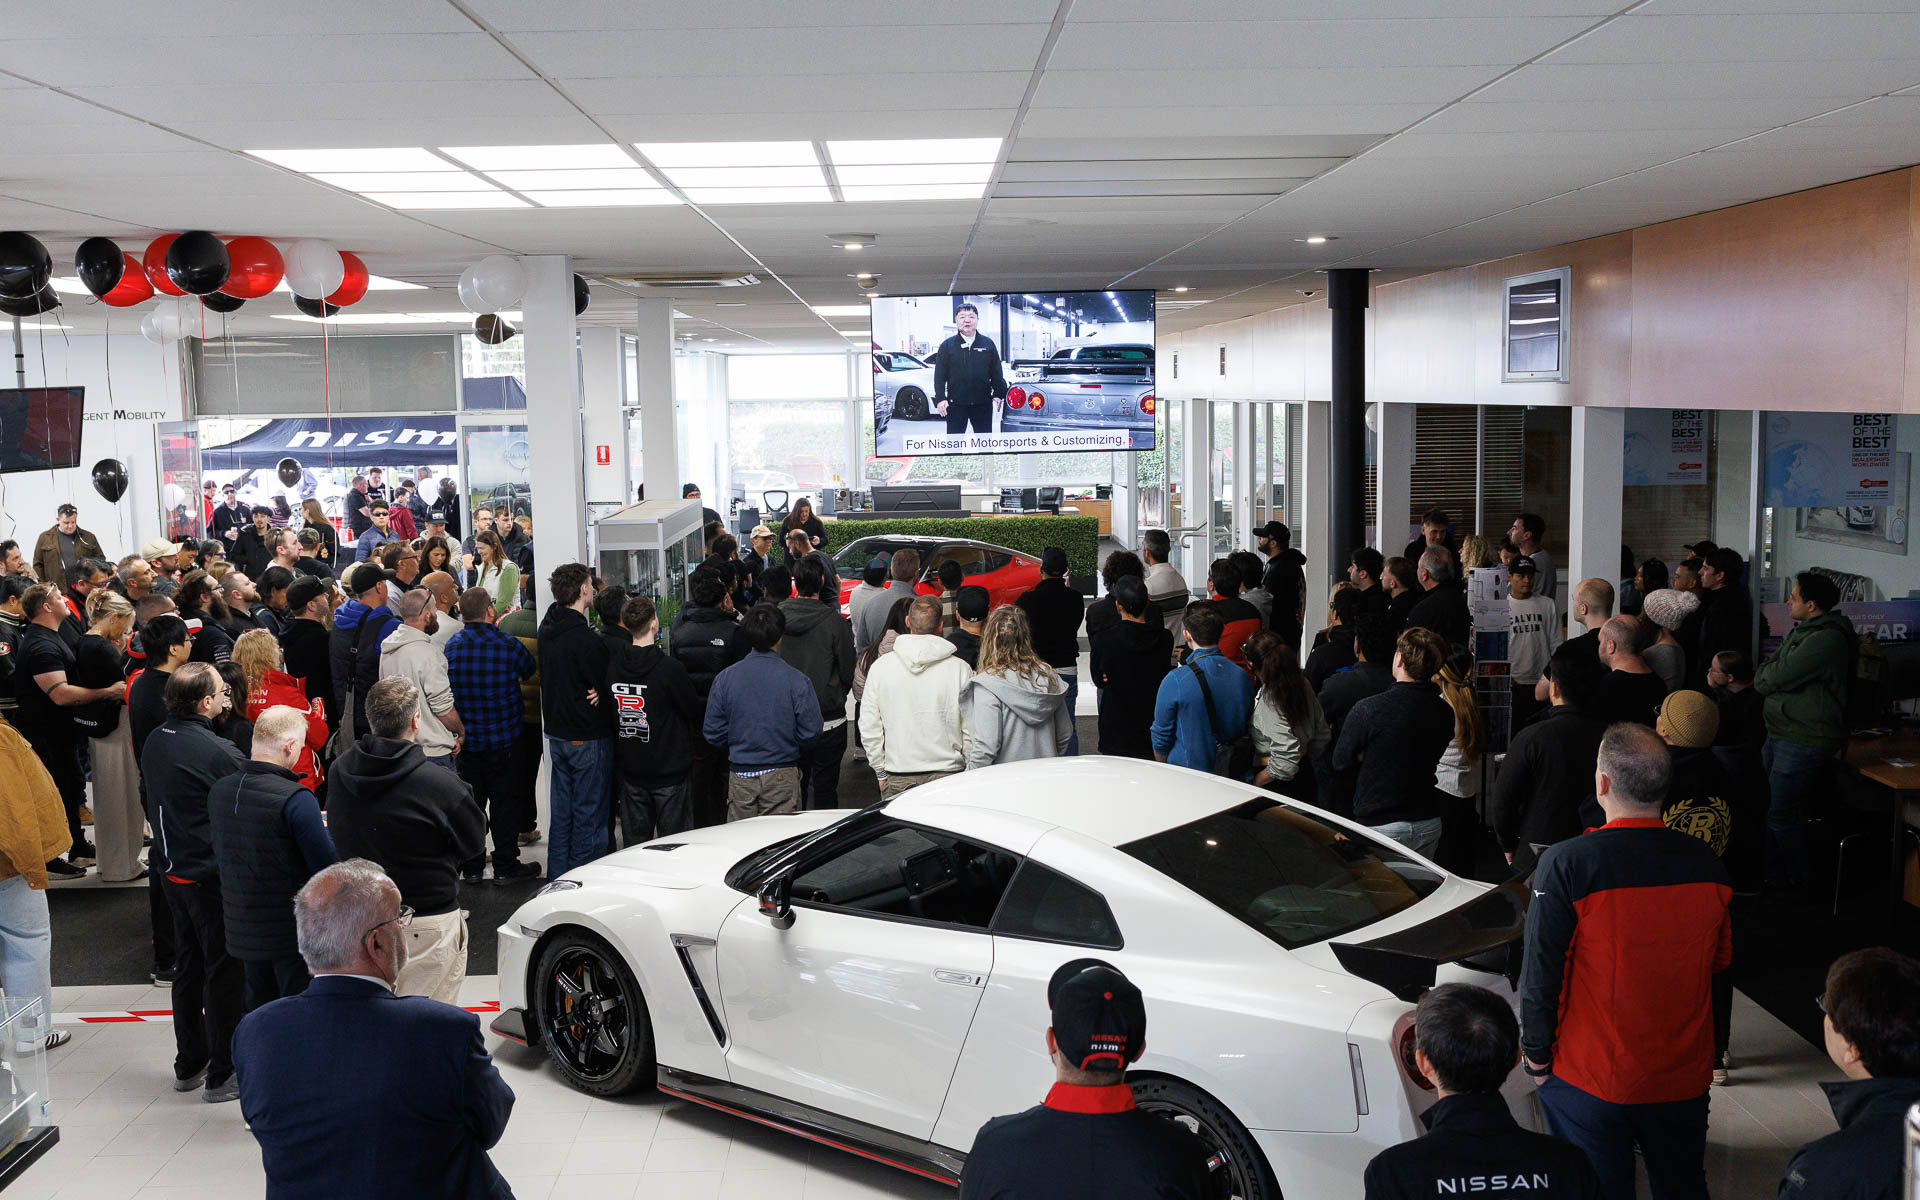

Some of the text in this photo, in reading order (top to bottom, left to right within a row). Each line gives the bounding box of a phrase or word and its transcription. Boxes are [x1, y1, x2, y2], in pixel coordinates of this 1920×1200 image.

[82, 409, 166, 421] GENT MOBILITY
[1672, 410, 1704, 420] BEST
[1853, 414, 1891, 426] BEST
[1672, 420, 1704, 428] OF THE
[1671, 428, 1703, 438] BEST
[1853, 426, 1891, 436] OF THE
[285, 428, 457, 448] nism
[906, 434, 1126, 450] For Nissan Motorsports & Customizing.
[1852, 436, 1891, 449] BEST
[1512, 624, 1541, 634] KLEIN
[611, 682, 648, 696] GT
[1091, 1033, 1128, 1043] NISSAN
[1090, 1043, 1126, 1052] nismo
[1436, 1173, 1549, 1194] NISSAN
